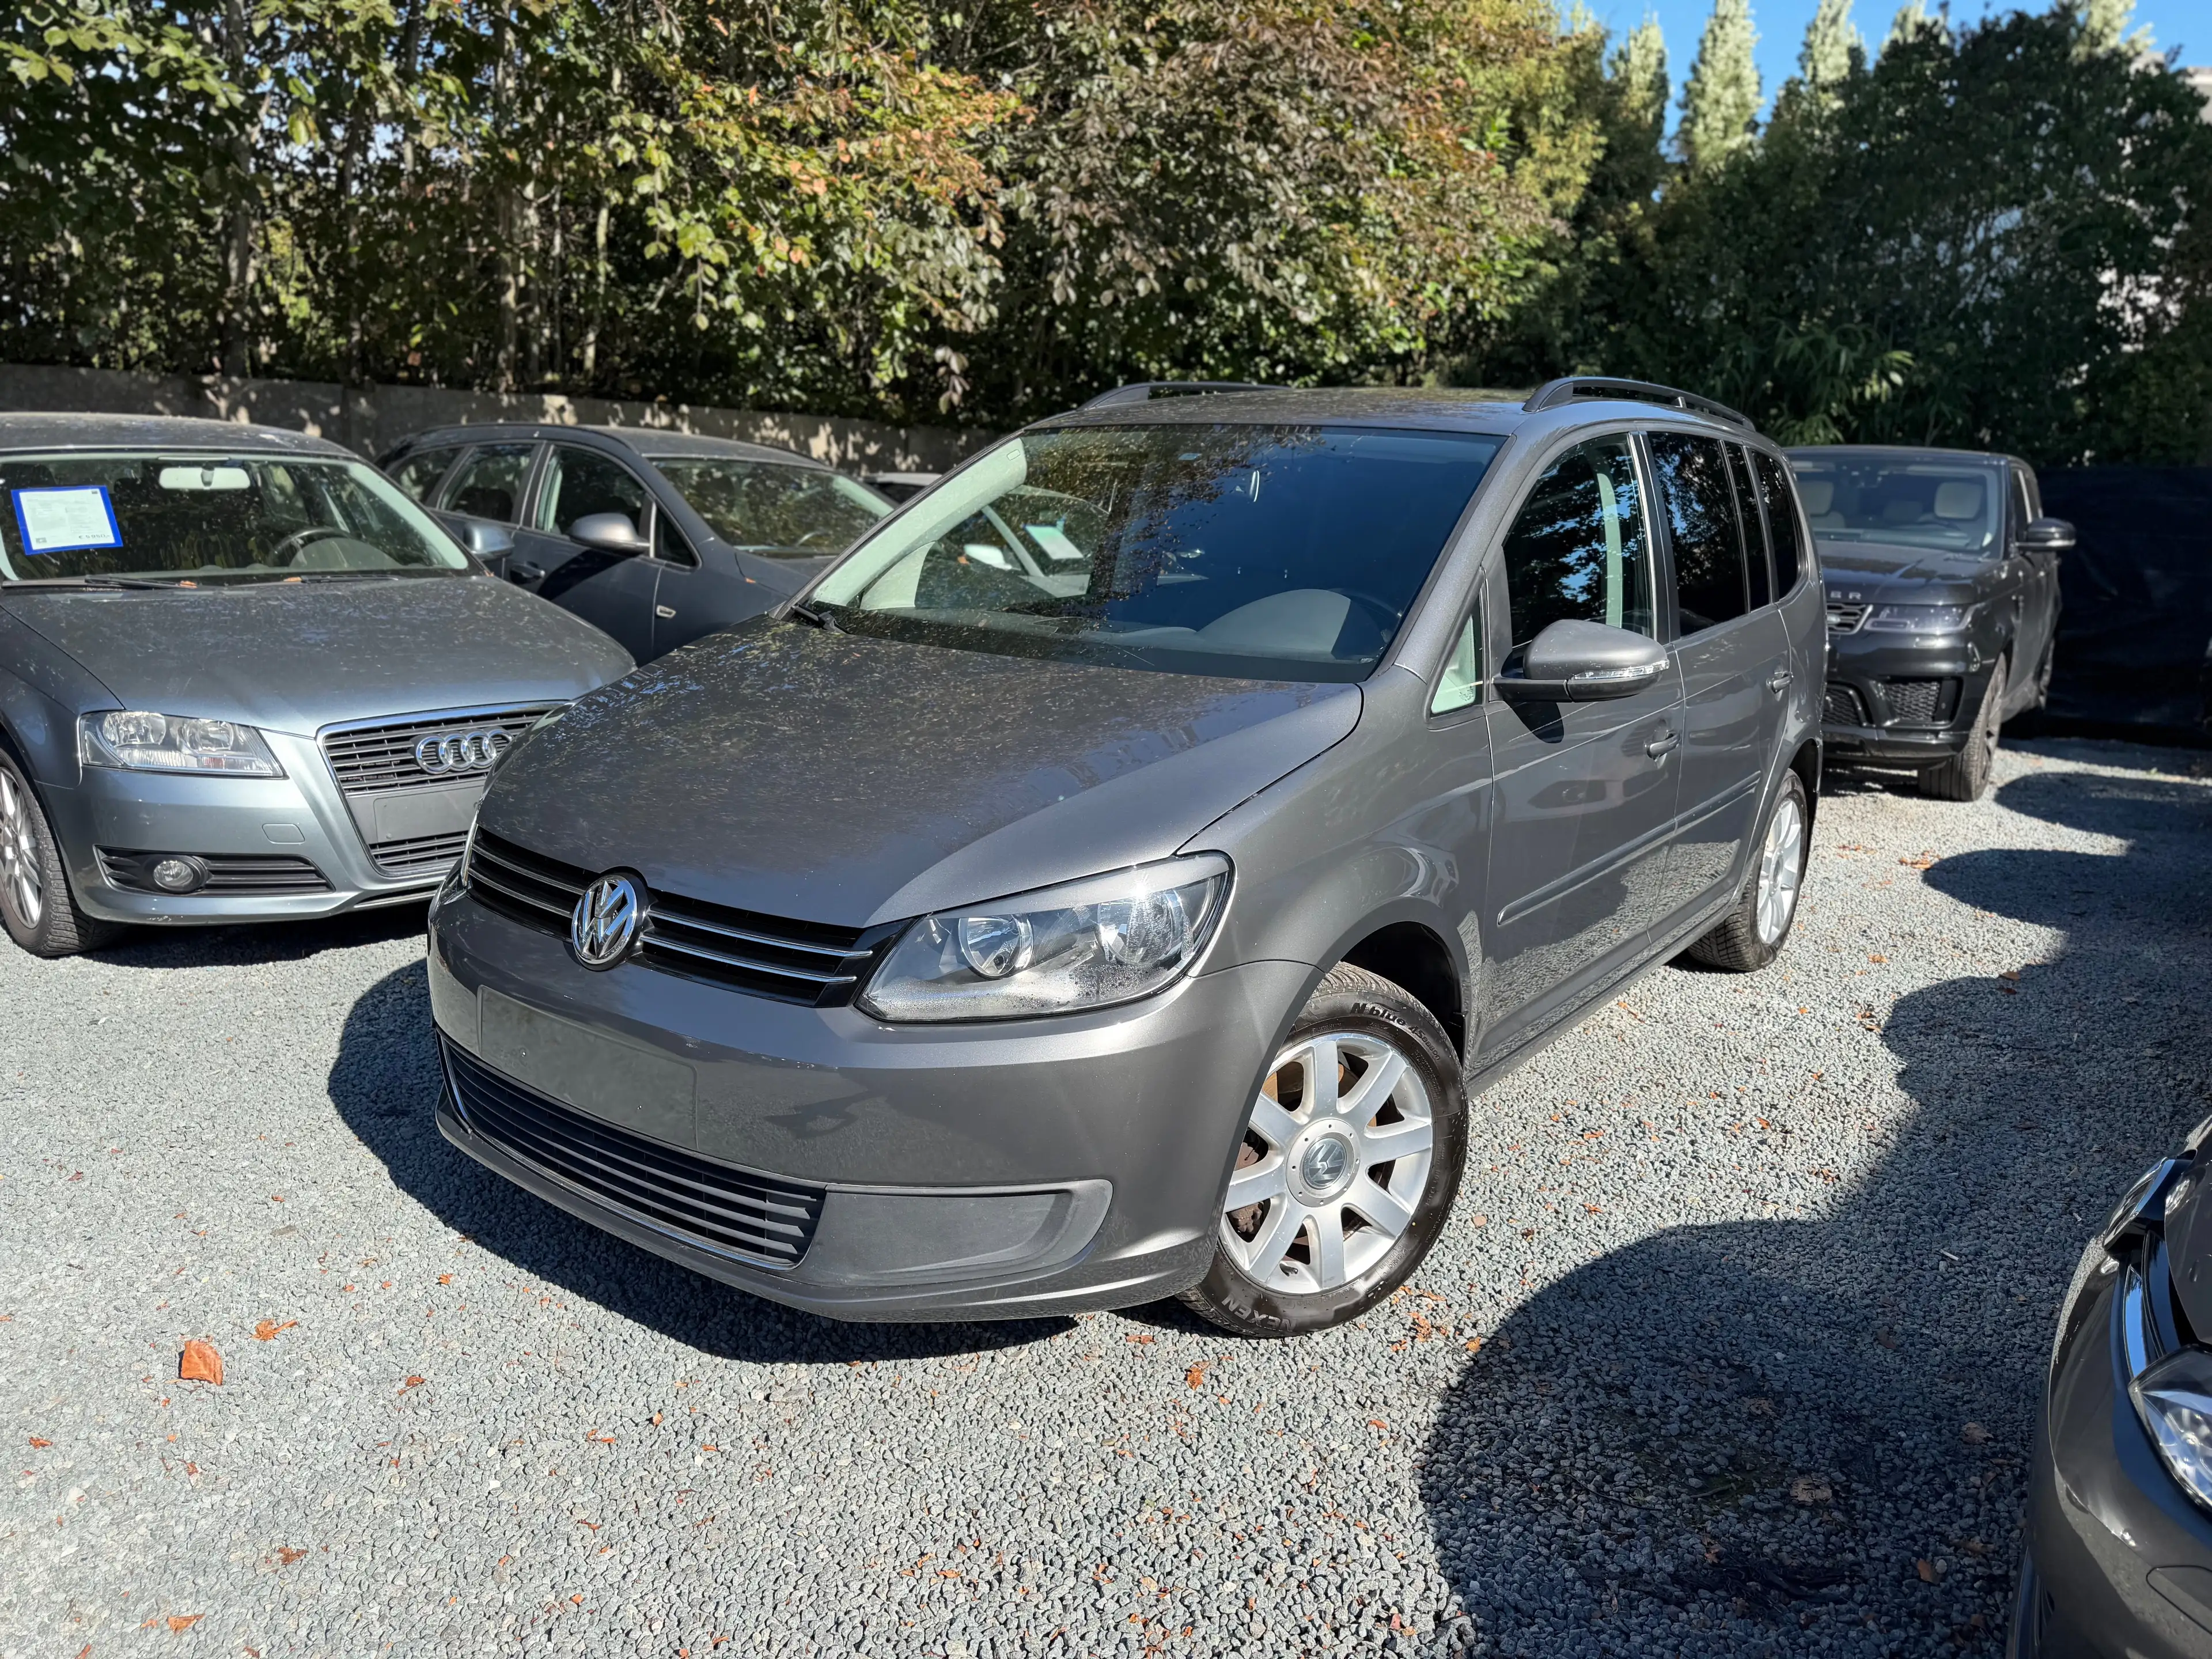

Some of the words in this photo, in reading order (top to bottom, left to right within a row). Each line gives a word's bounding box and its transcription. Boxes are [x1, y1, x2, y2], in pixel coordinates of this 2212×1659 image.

[1831, 590, 1861, 600] ER
[573, 876, 636, 962] VW
[1369, 1006, 1406, 1026] blue
[1221, 1295, 1297, 1332] NEXEN
